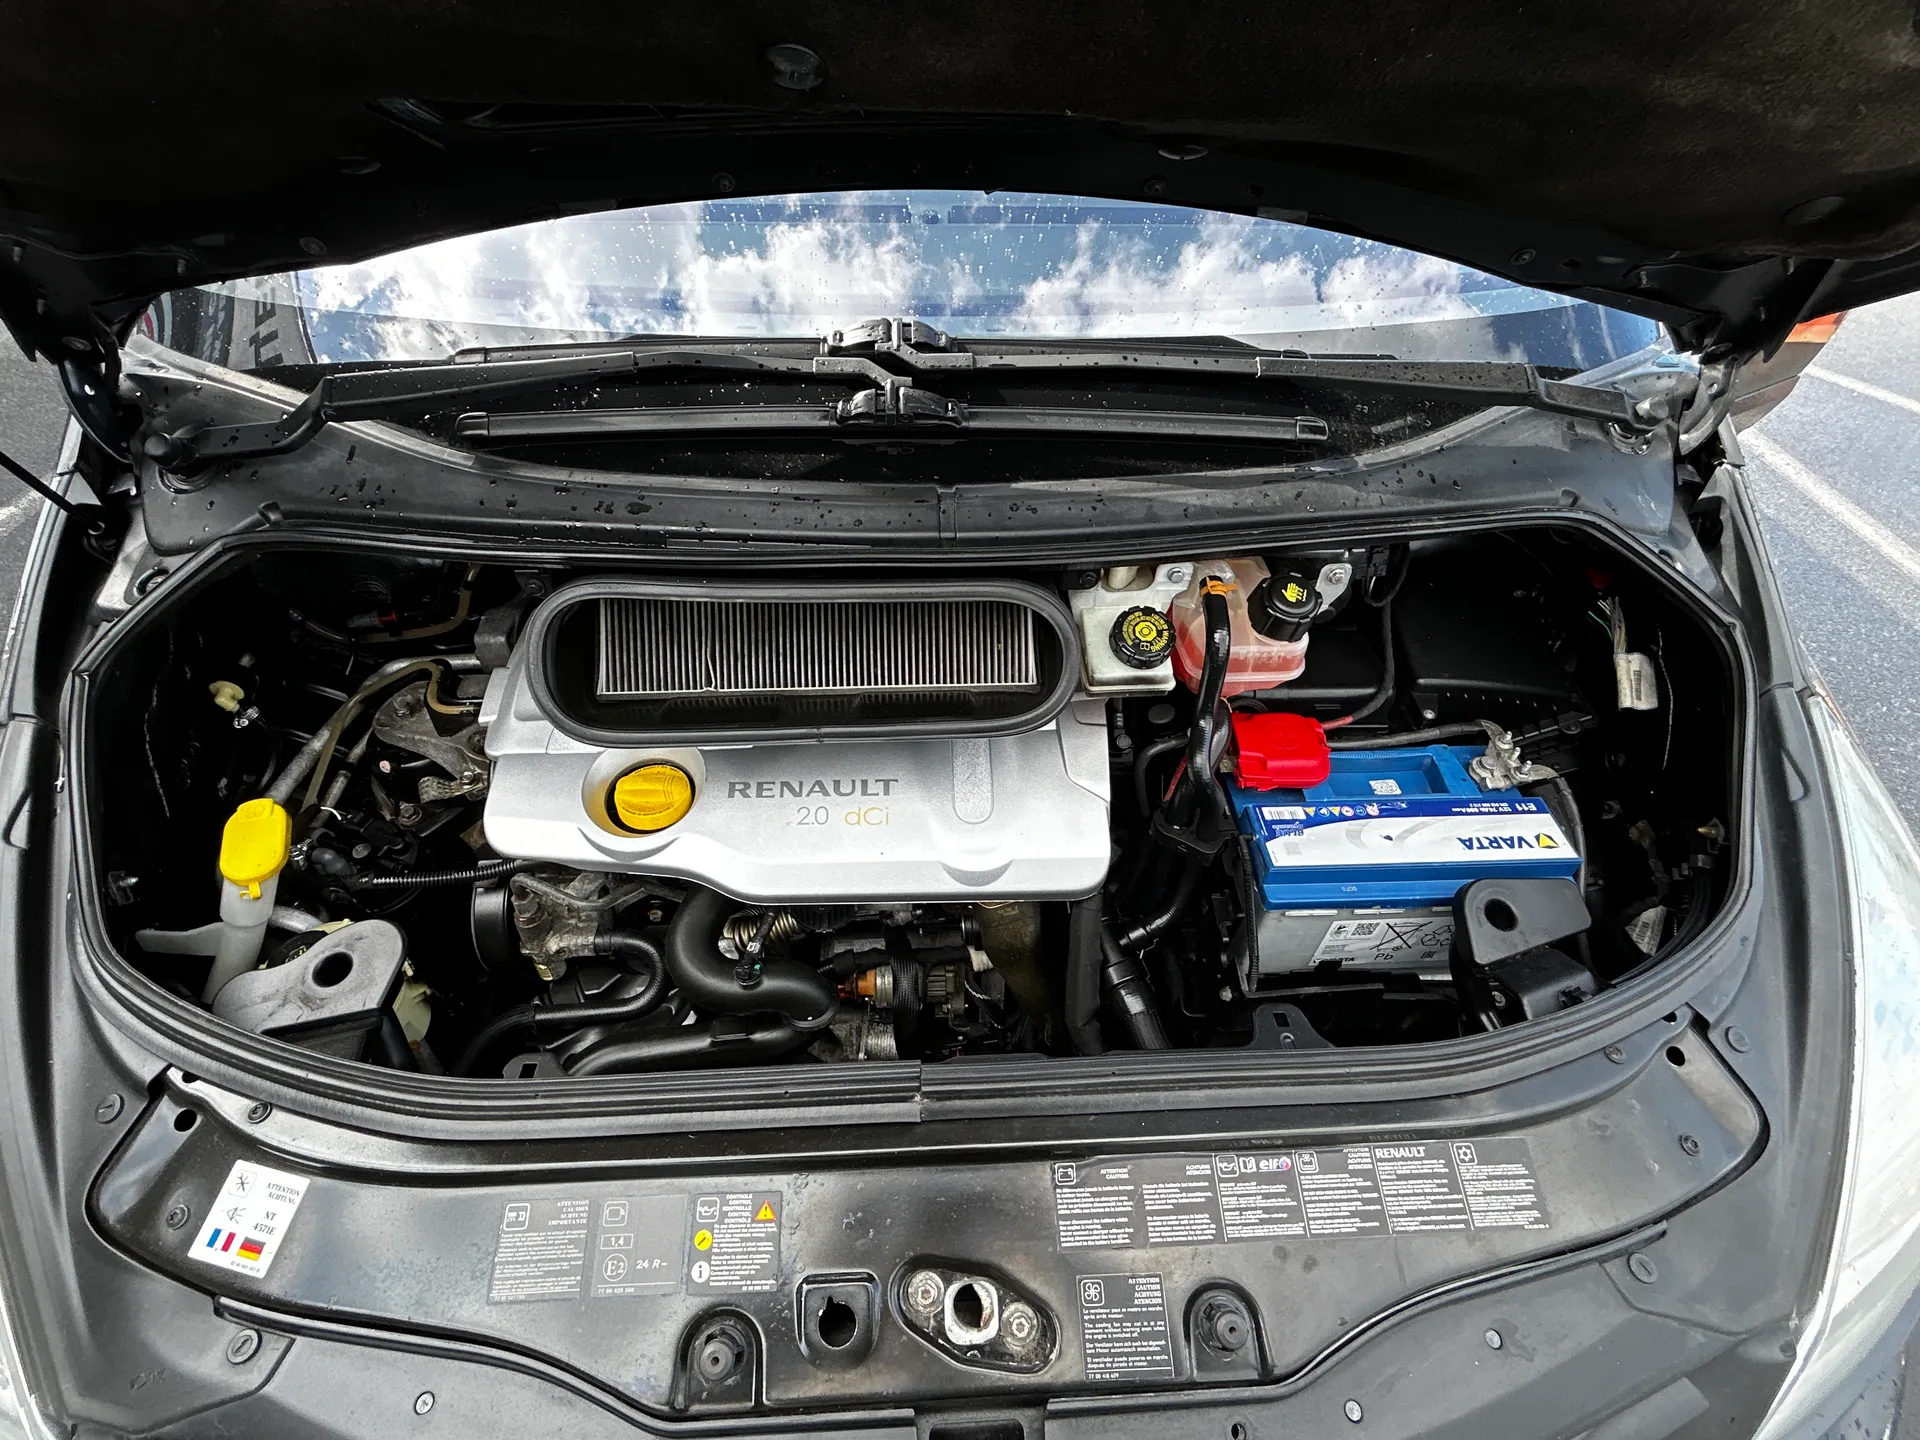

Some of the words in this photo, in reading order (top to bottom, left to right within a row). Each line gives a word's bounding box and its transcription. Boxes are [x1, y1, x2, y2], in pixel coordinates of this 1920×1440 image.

[727, 778, 899, 800] RENAULT
[1515, 802, 1538, 811] E11
[796, 806, 830, 826] 2.0
[844, 807, 890, 826] dCi
[1456, 836, 1535, 850] VARTA
[1374, 952, 1394, 960] Pb
[1374, 1146, 1426, 1158] RENAULT
[1259, 1158, 1280, 1170] elf
[266, 1182, 300, 1197] ATTENTION
[267, 1192, 296, 1204] ACHTUNG
[264, 1211, 277, 1221] NT
[636, 1259, 650, 1269] 24
